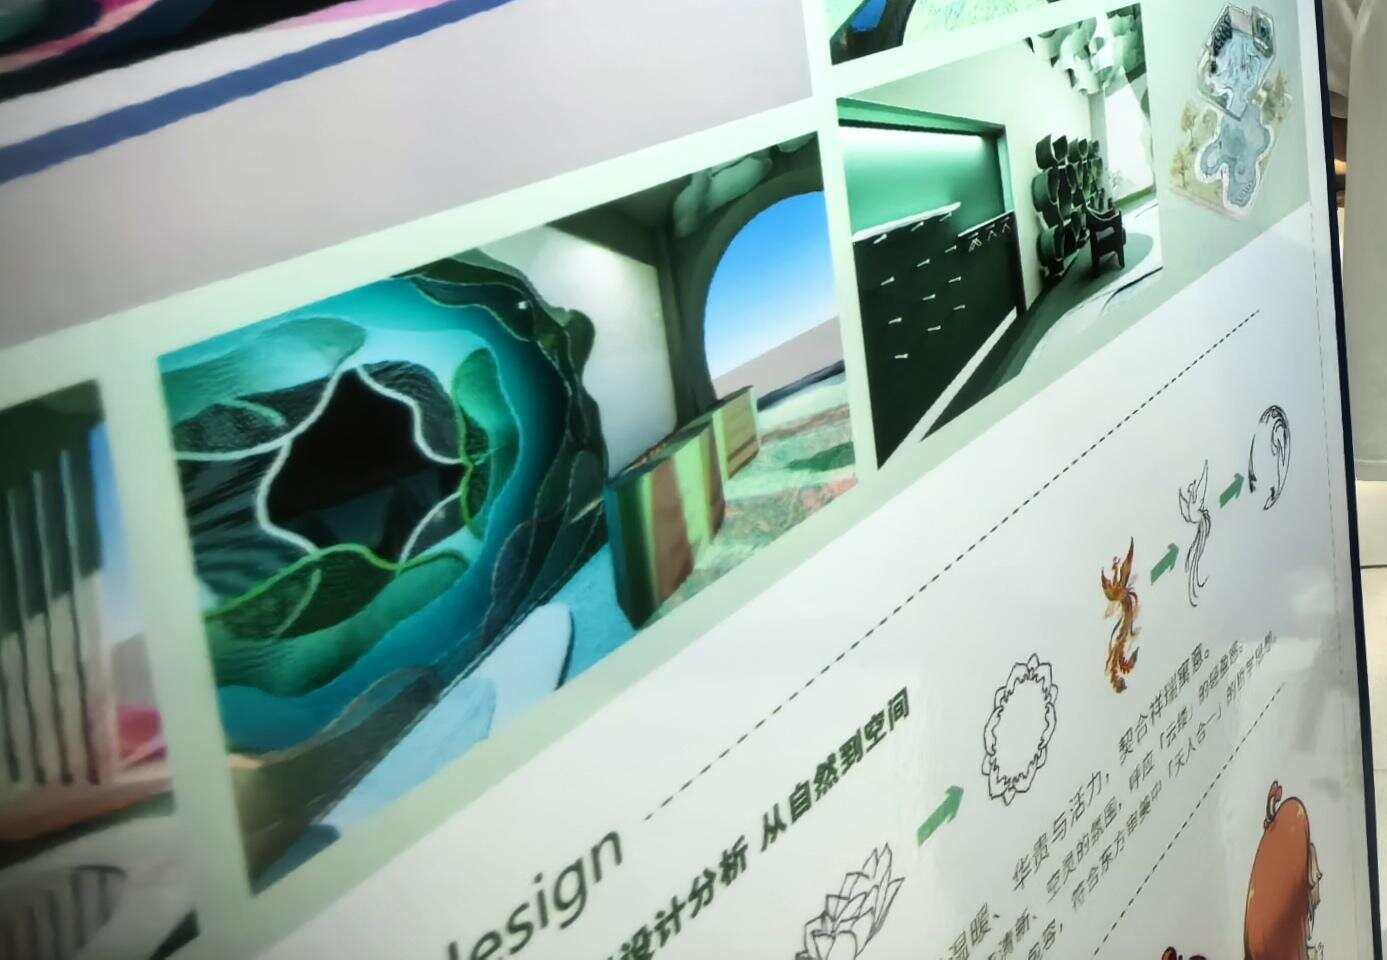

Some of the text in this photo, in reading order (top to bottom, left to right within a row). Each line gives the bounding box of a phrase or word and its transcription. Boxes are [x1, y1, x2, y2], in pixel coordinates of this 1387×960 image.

[760, 686, 910, 852] 从自然到空间
[445, 828, 623, 960] esign
